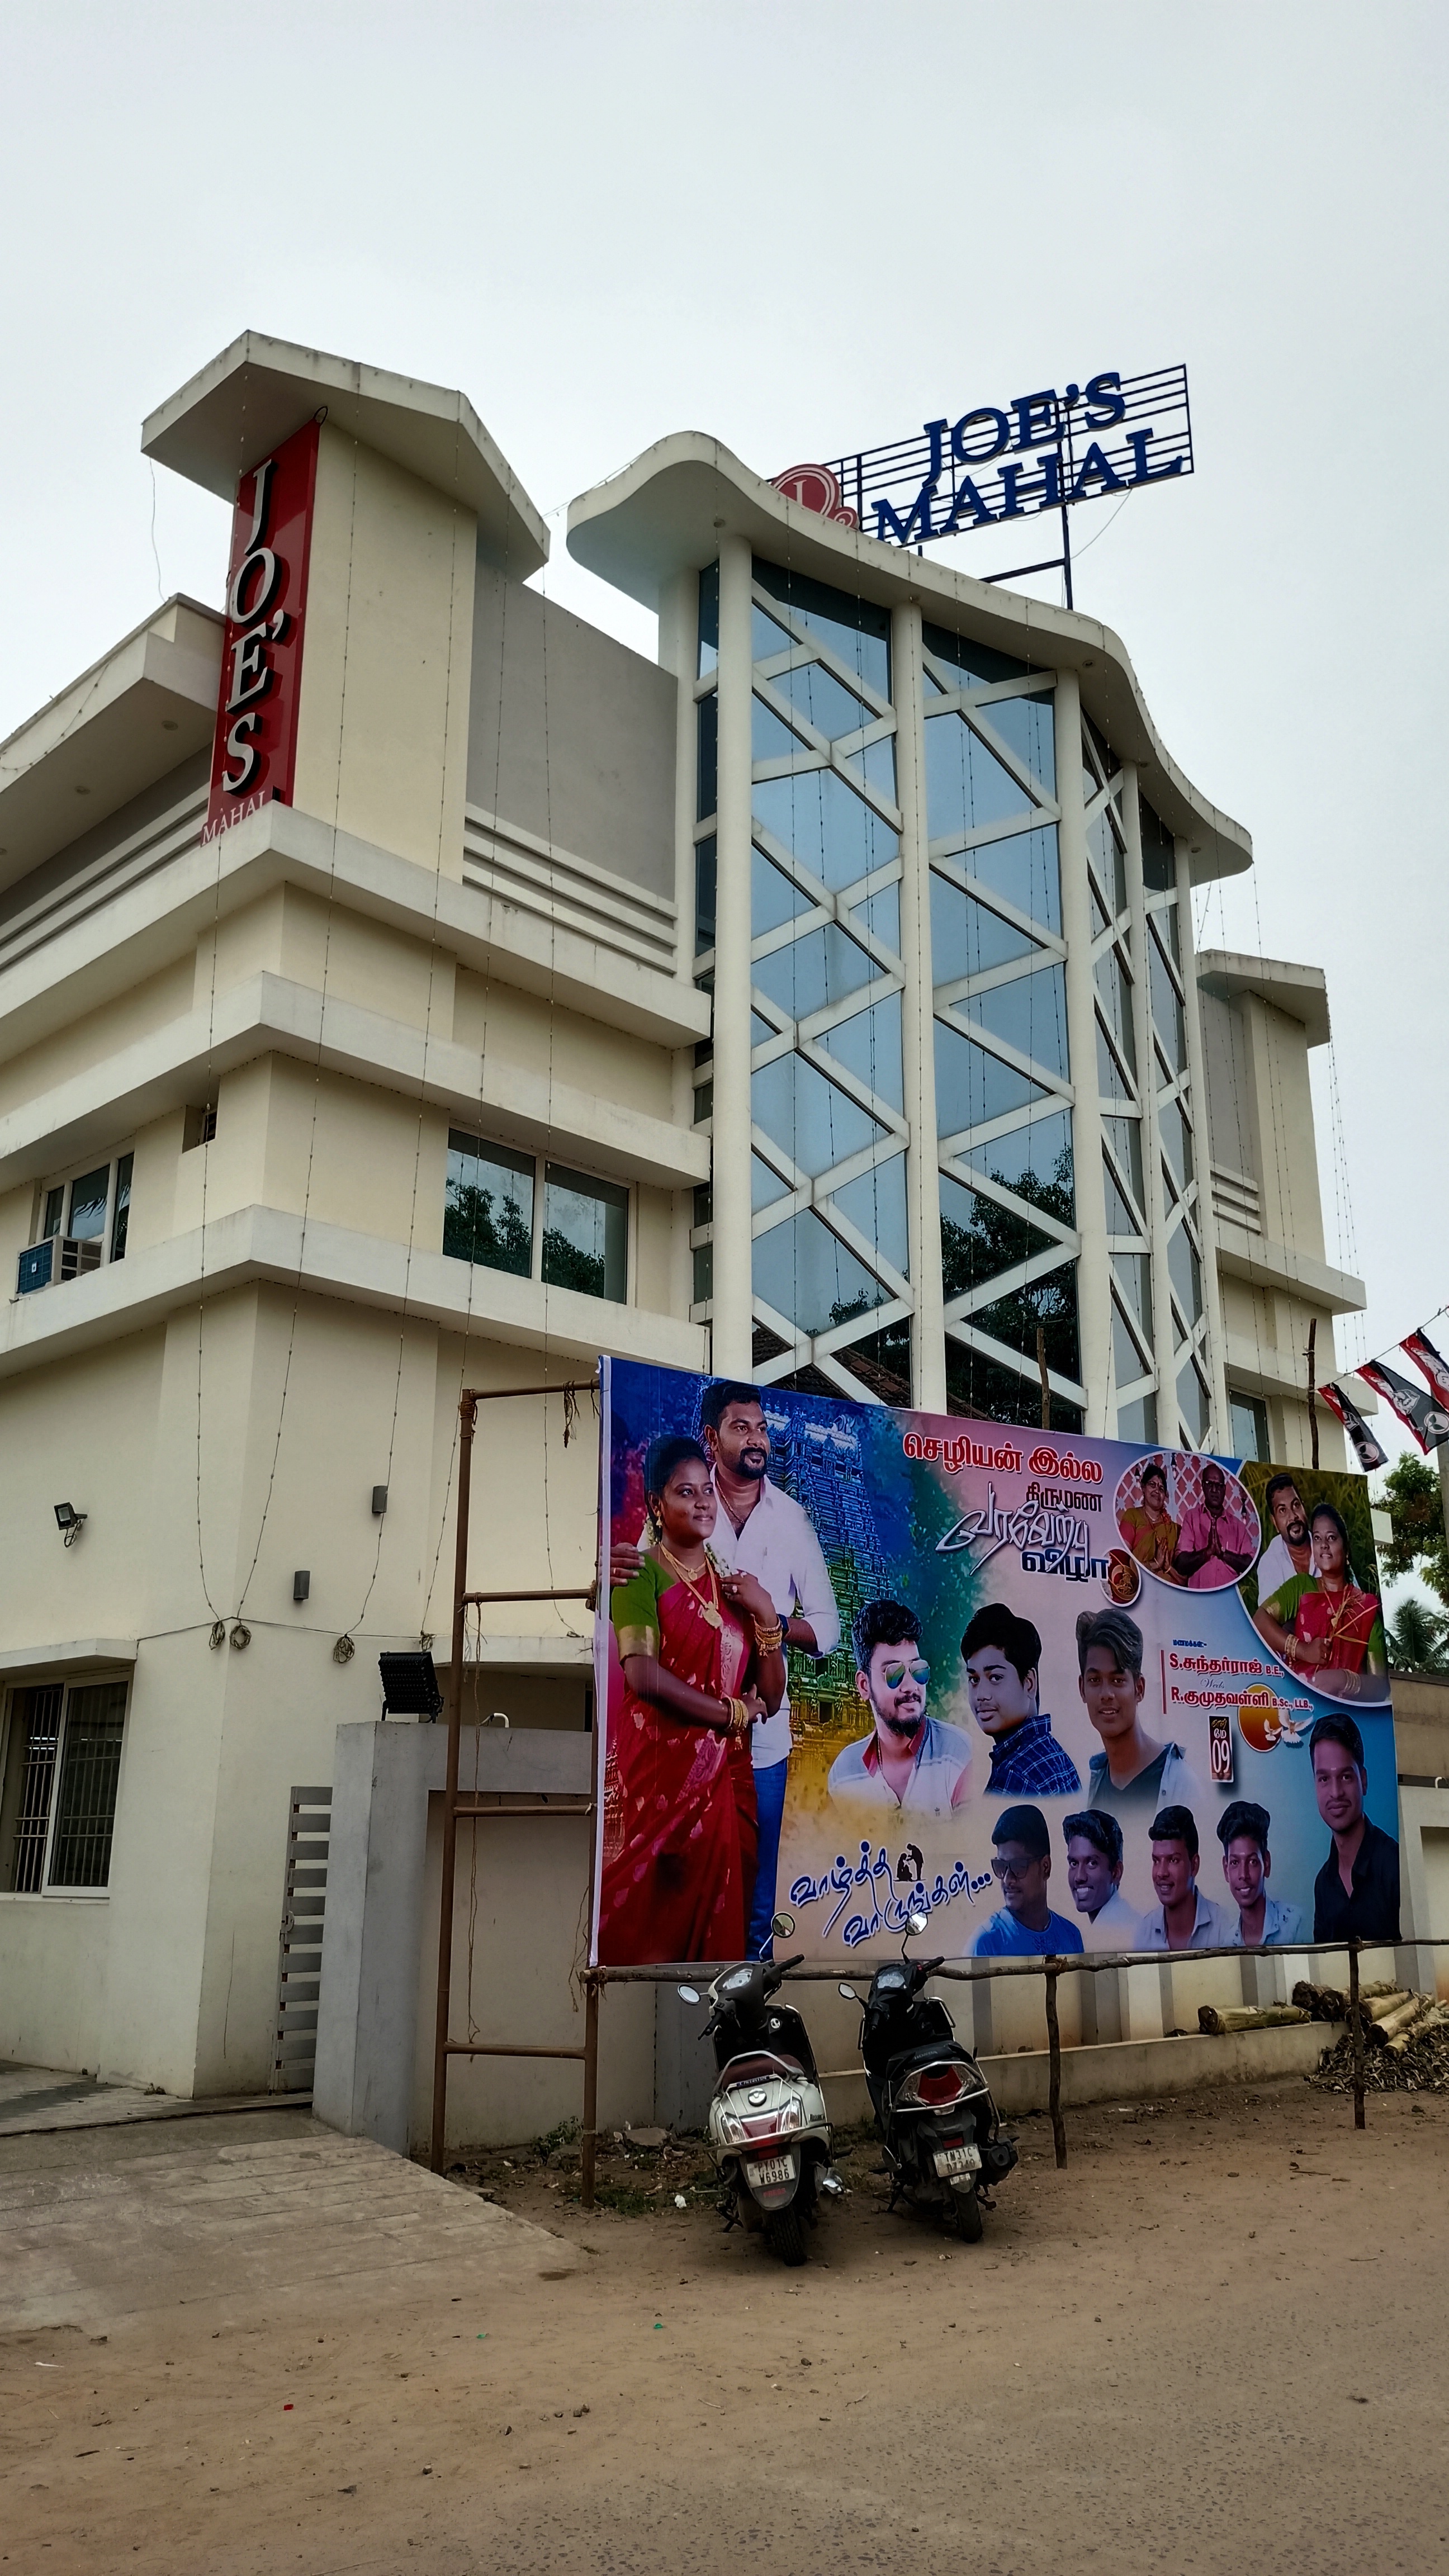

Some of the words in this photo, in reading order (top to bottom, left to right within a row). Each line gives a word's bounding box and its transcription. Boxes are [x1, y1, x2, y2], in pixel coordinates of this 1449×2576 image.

[923, 372, 1126, 488] JOE'S
[871, 428, 1183, 547] MAHAL
[222, 459, 286, 793] JOE'S
[903, 1432, 1024, 1475] செழியன்
[1027, 1445, 1104, 1484] இல்ல
[1026, 1481, 1104, 1512] திருமண
[1022, 1548, 1109, 1583] விழா
[1212, 1739, 1230, 1773] 09
[1214, 1728, 1227, 1739] மே
[789, 1840, 898, 1938] வாழ்த்த
